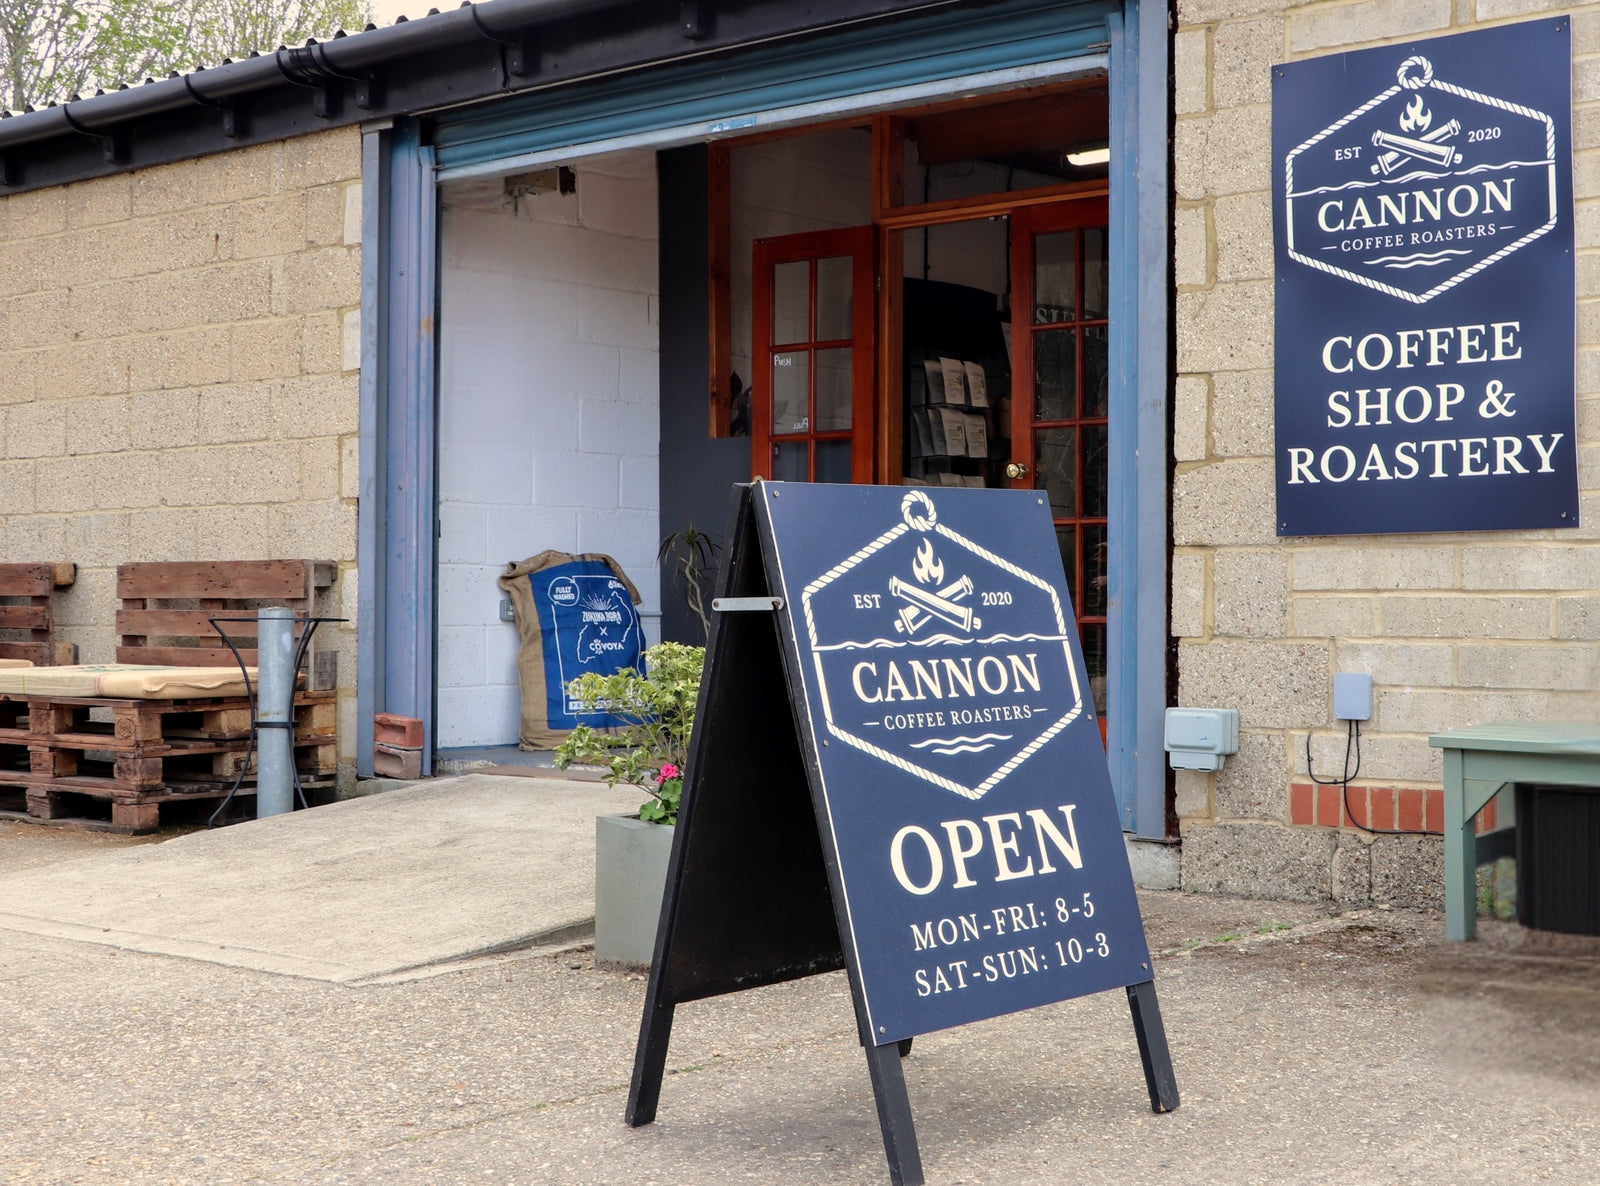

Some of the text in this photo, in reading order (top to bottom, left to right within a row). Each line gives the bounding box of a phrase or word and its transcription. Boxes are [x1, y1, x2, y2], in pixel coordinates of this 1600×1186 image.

[1335, 147, 1361, 160] EST
[1468, 127, 1501, 142] 2020
[1318, 179, 1515, 232] CANNON
[1342, 224, 1496, 252] COFFEE ROASTERS
[1322, 321, 1522, 373] COFFEE
[1327, 380, 1516, 428] SHOP &
[1287, 433, 1564, 484] ROASTERY
[555, 586, 573, 594] FULLY
[854, 594, 881, 609] EST
[981, 591, 1013, 606] 2020
[589, 642, 625, 652] COVOYA
[852, 654, 1041, 703] CANNON
[884, 705, 1032, 730] COFFEE ROASTERS
[890, 804, 1083, 896] OPEN
[910, 893, 1095, 951] MON-FRI: 8-5
[915, 932, 1110, 997] SAT-SUN: 10-3
